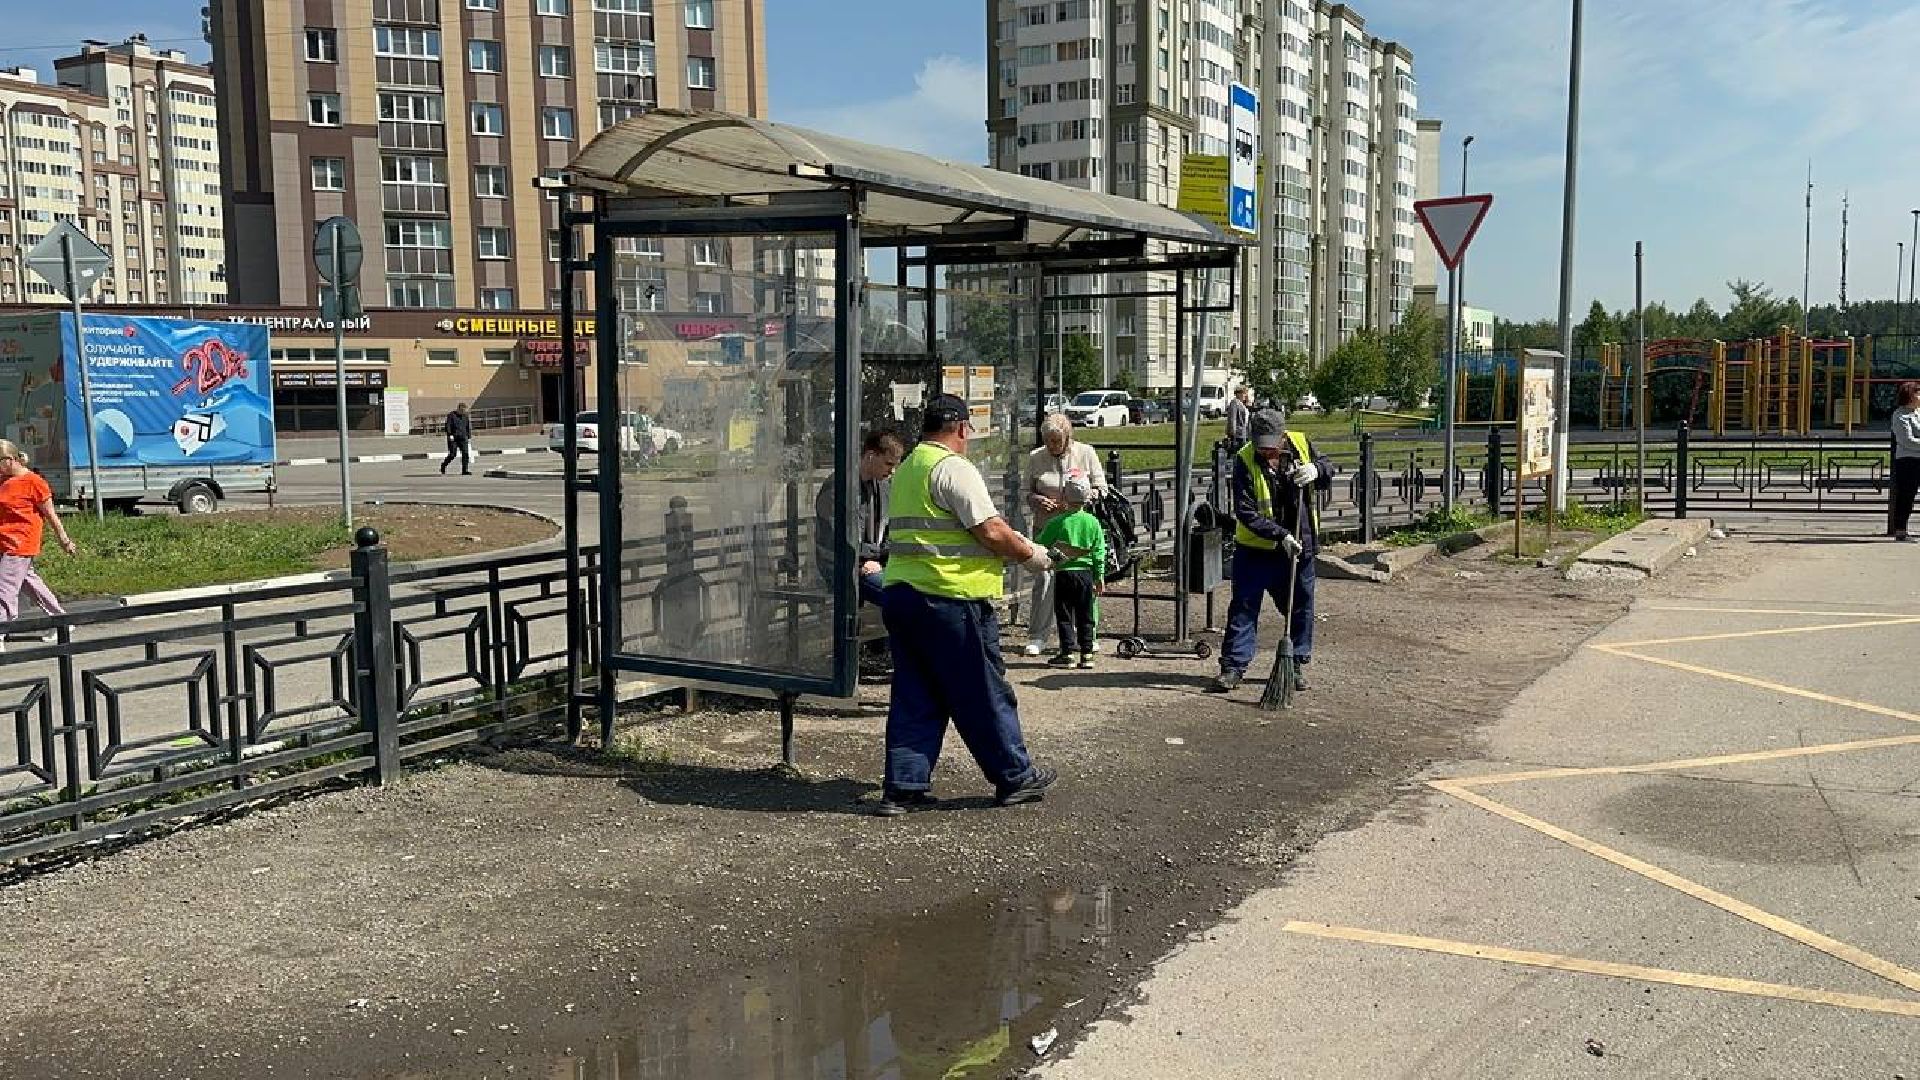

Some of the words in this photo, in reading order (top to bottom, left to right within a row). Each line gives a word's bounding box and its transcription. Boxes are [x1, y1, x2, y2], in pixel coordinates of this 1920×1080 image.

[252, 315, 371, 329] ЦЕНТРАЛЬЫЙ
[456, 318, 556, 333] СМЕШНЫЕ
[85, 343, 145, 356] ОЛУЧАЙТЕ
[89, 356, 174, 368] УДЕРЖИВАЙТЕ
